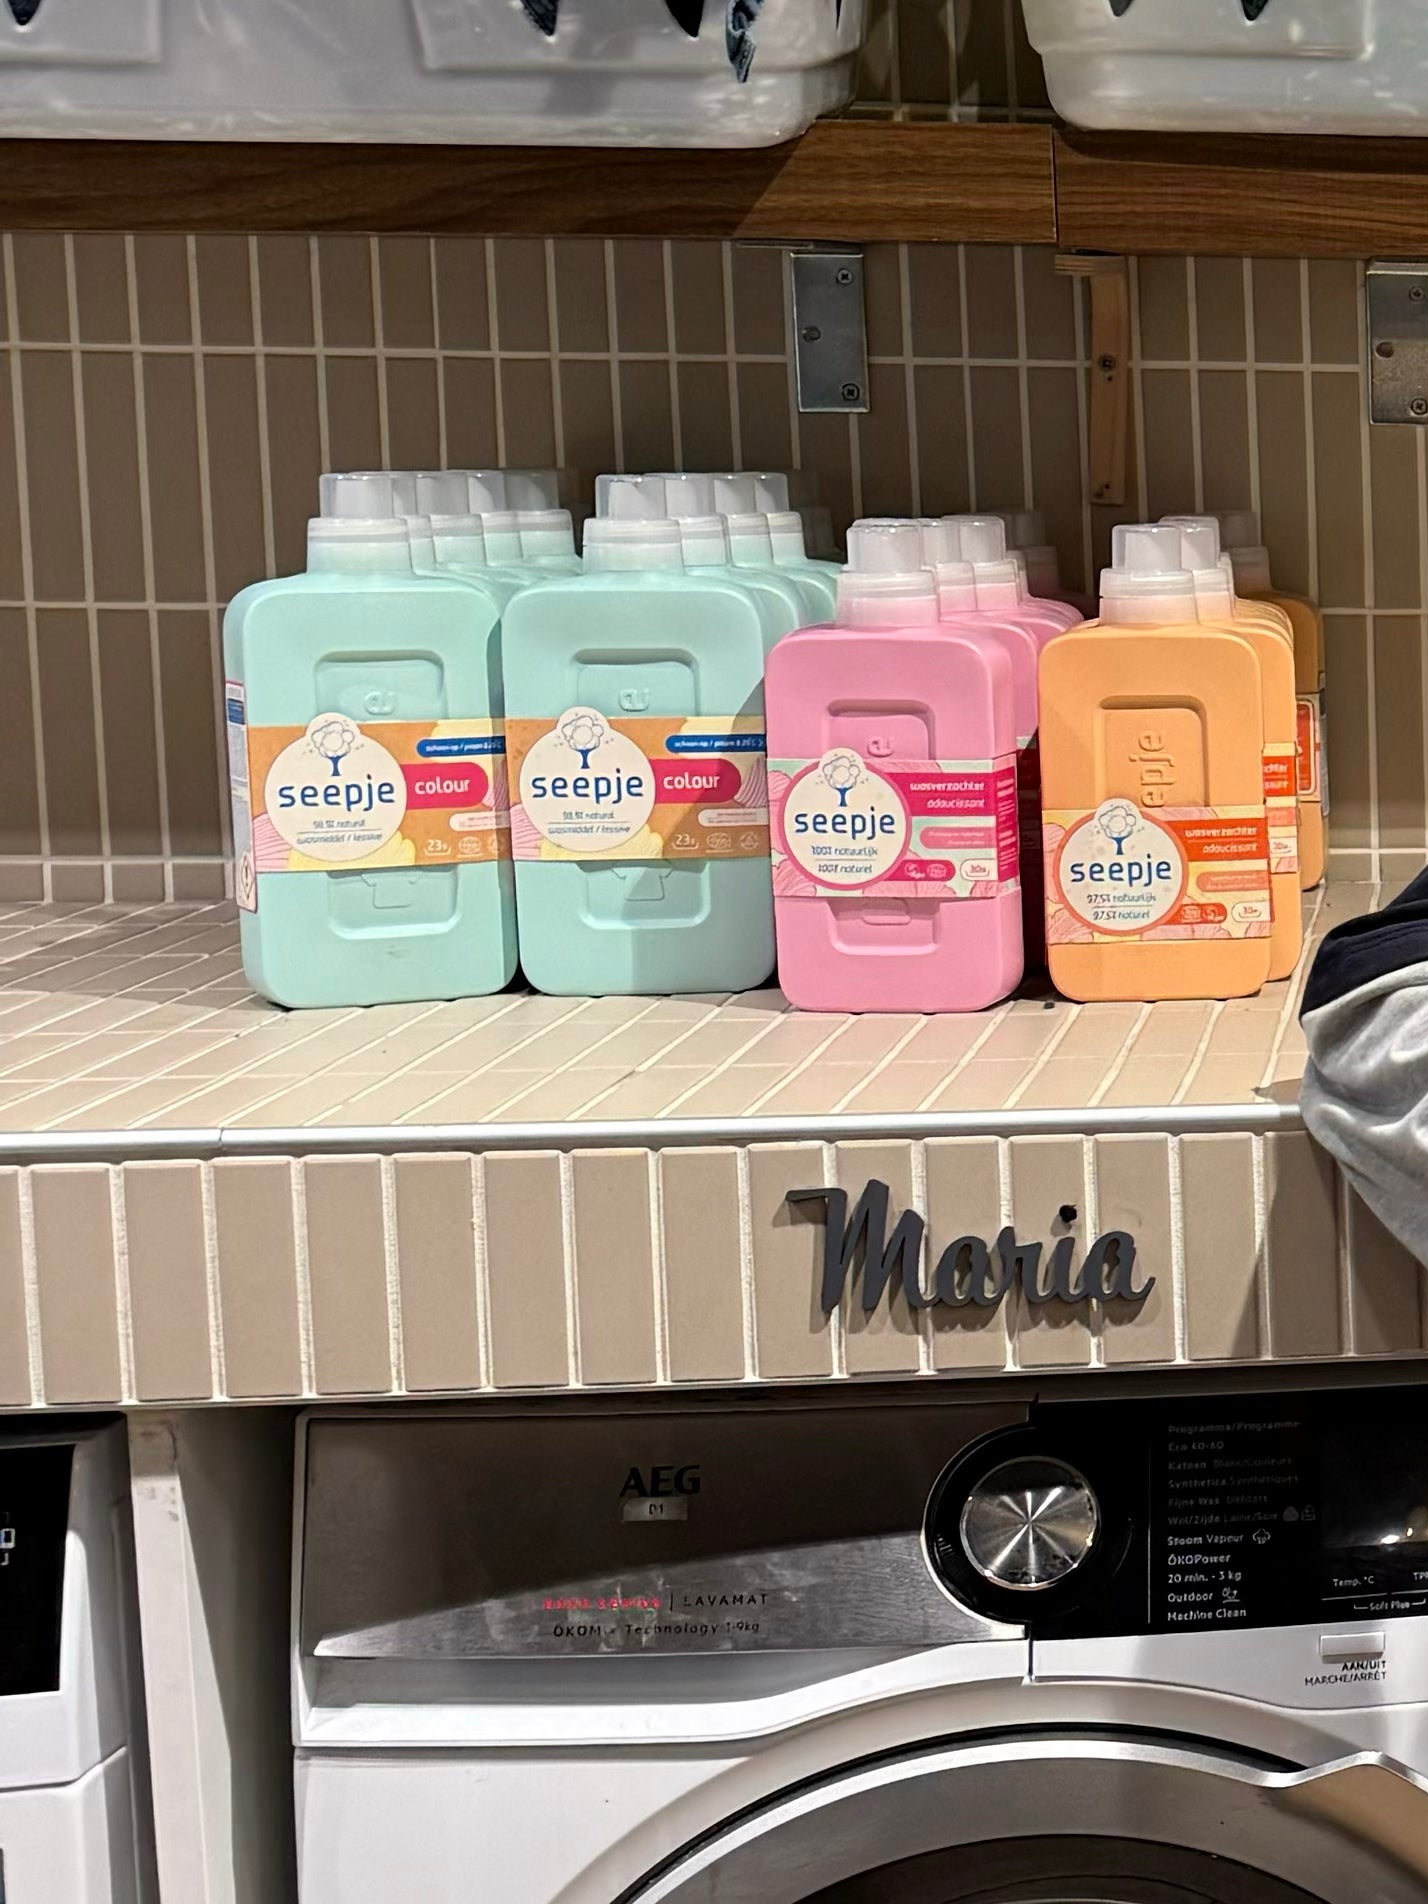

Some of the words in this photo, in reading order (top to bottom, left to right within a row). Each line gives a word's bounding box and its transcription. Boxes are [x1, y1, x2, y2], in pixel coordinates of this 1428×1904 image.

[415, 775, 471, 795] colour
[531, 767, 644, 805] seepje
[663, 772, 720, 790] colour
[910, 781, 985, 792] wasverzachter
[278, 773, 396, 812] seepje
[794, 805, 896, 841] seepje
[1185, 825, 1257, 837] wasverzachter
[1069, 853, 1172, 887] seepje
[785, 1179, 1156, 1313] Maria
[620, 1465, 701, 1498] AEG
[1168, 1573, 1182, 1584] 20
[1228, 1569, 1242, 1582] kg
[683, 1594, 769, 1608] LAVAMAT
[1167, 1592, 1213, 1603] Outdoor
[1369, 1600, 1387, 1611] Soft
[1389, 1599, 1410, 1610] Plus
[1168, 1610, 1213, 1621] Machine
[1216, 1608, 1247, 1619] Clean
[625, 1623, 719, 1636] Technology
